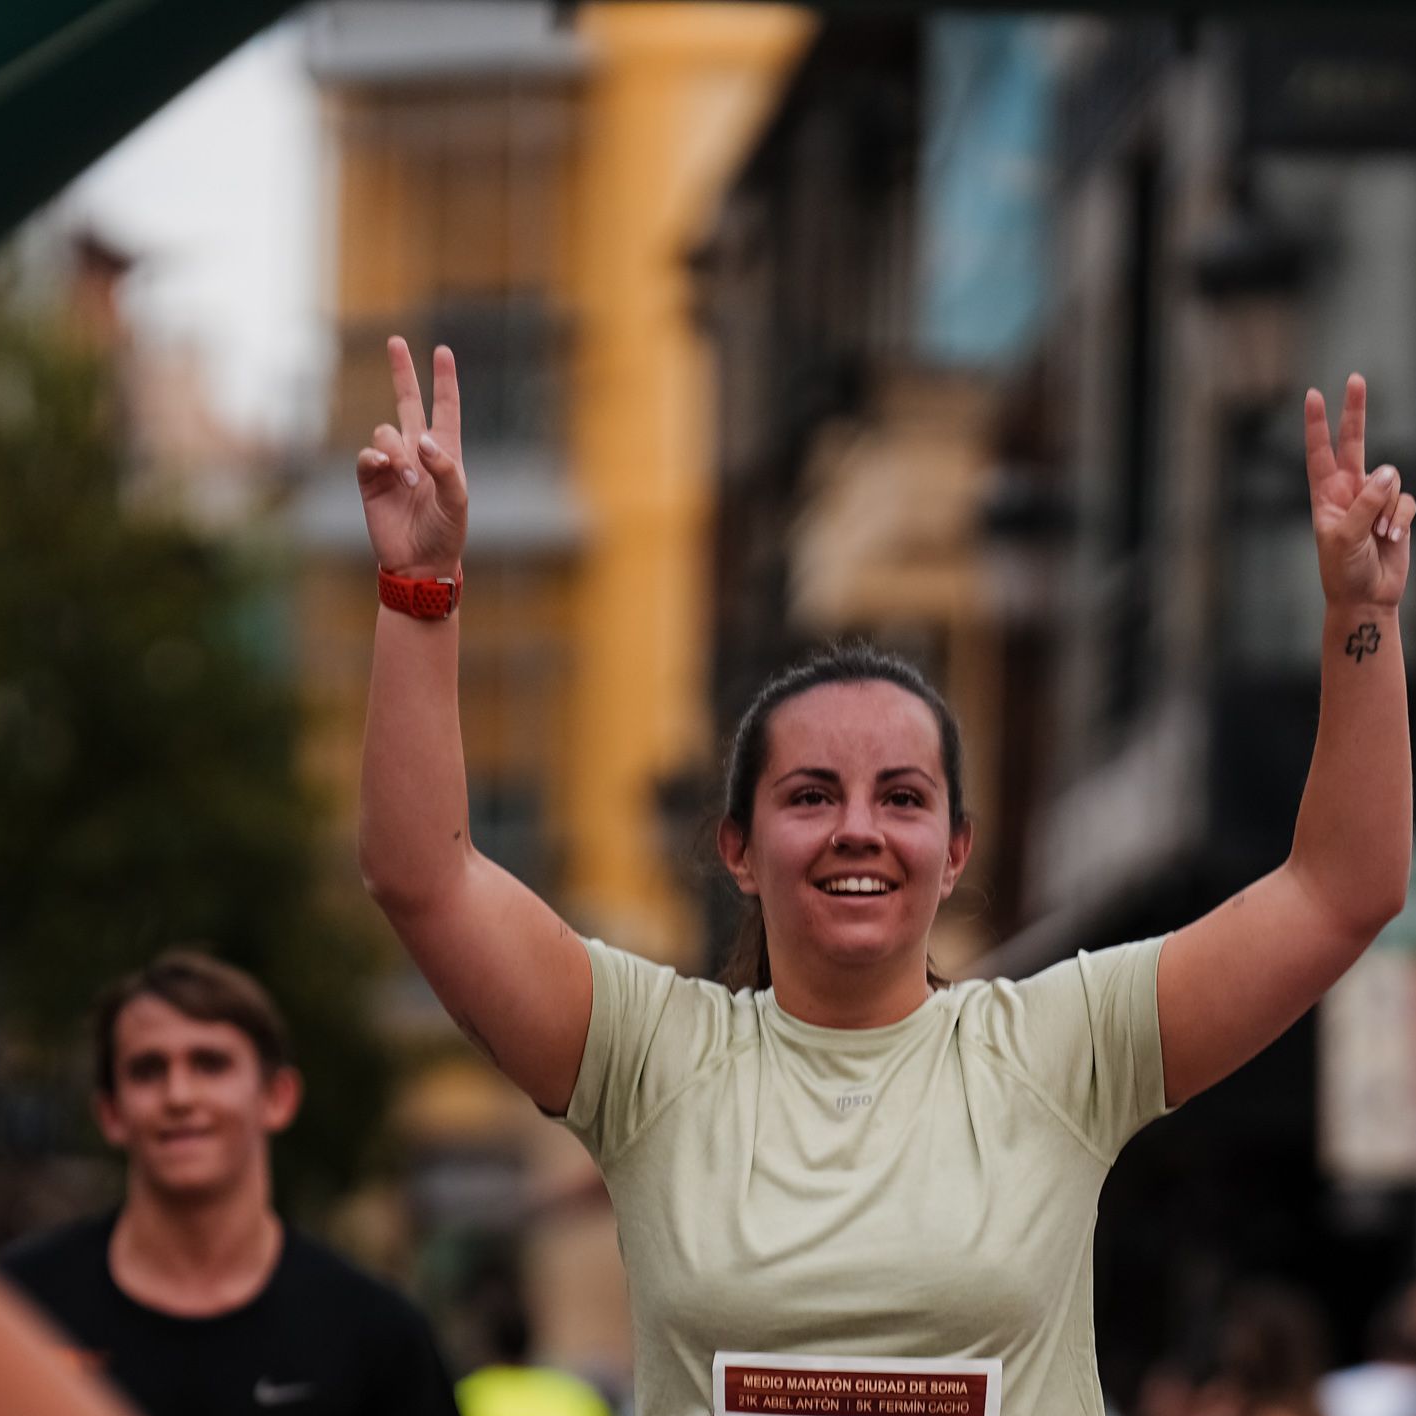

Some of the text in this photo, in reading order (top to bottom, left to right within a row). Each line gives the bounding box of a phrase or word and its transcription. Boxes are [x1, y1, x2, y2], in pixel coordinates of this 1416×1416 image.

[743, 1374, 968, 1394] MEDIO MARATÓN CIUDAD DE SORIA
[762, 1396, 793, 1409] ABEL
[795, 1397, 840, 1412] ANTÓN
[878, 1398, 926, 1413] FERMÍN
[928, 1400, 970, 1414] CACHO
